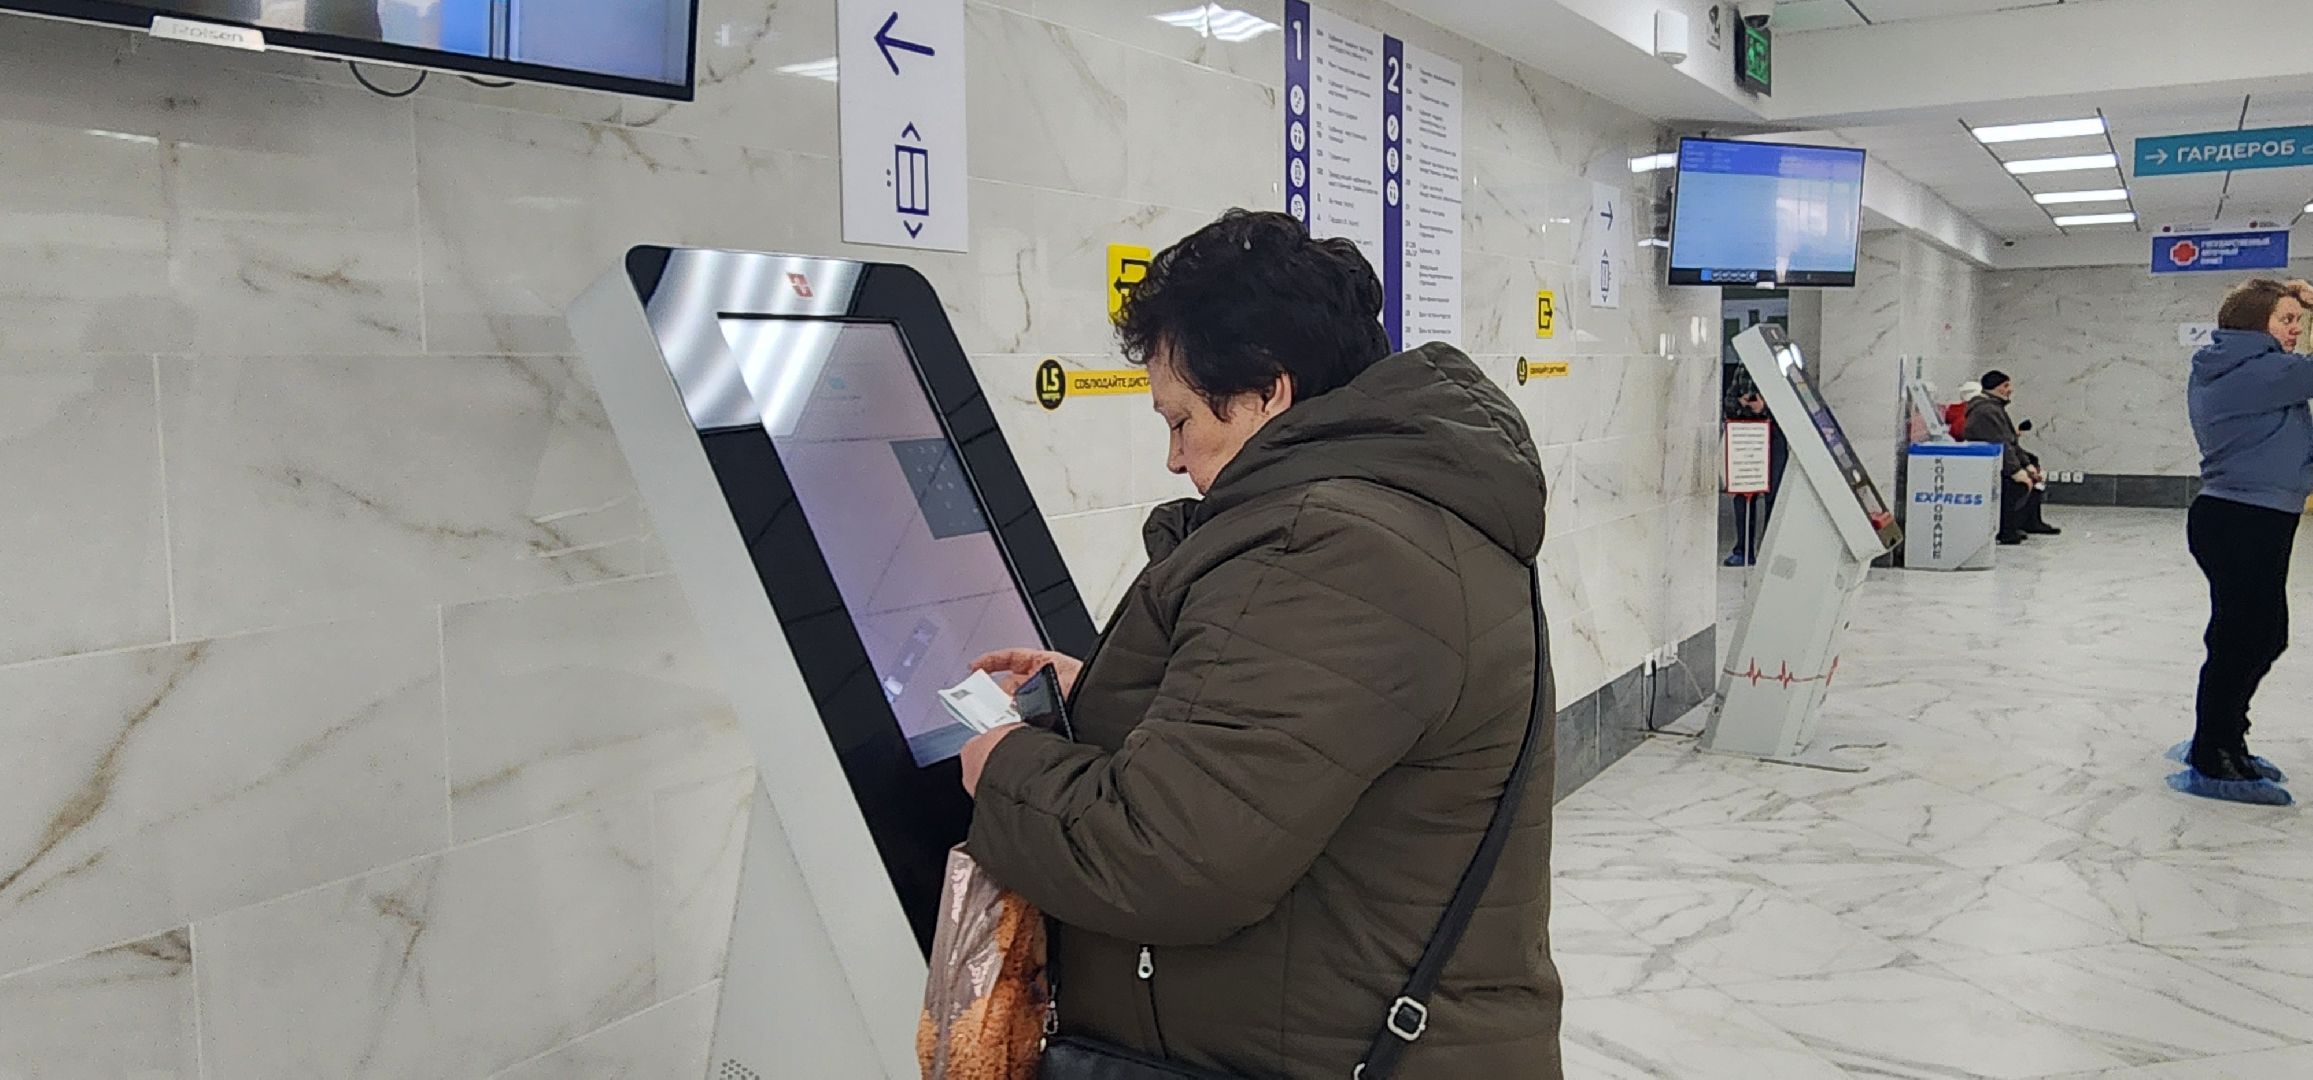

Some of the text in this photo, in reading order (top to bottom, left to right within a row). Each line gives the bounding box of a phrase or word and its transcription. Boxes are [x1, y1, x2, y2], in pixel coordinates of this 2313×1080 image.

[1293, 20, 1302, 61] 1
[1387, 56, 1400, 94] 2
[2177, 138, 2296, 163] ГАРДЕРОБ
[1914, 492, 1984, 505] EXPRESS
